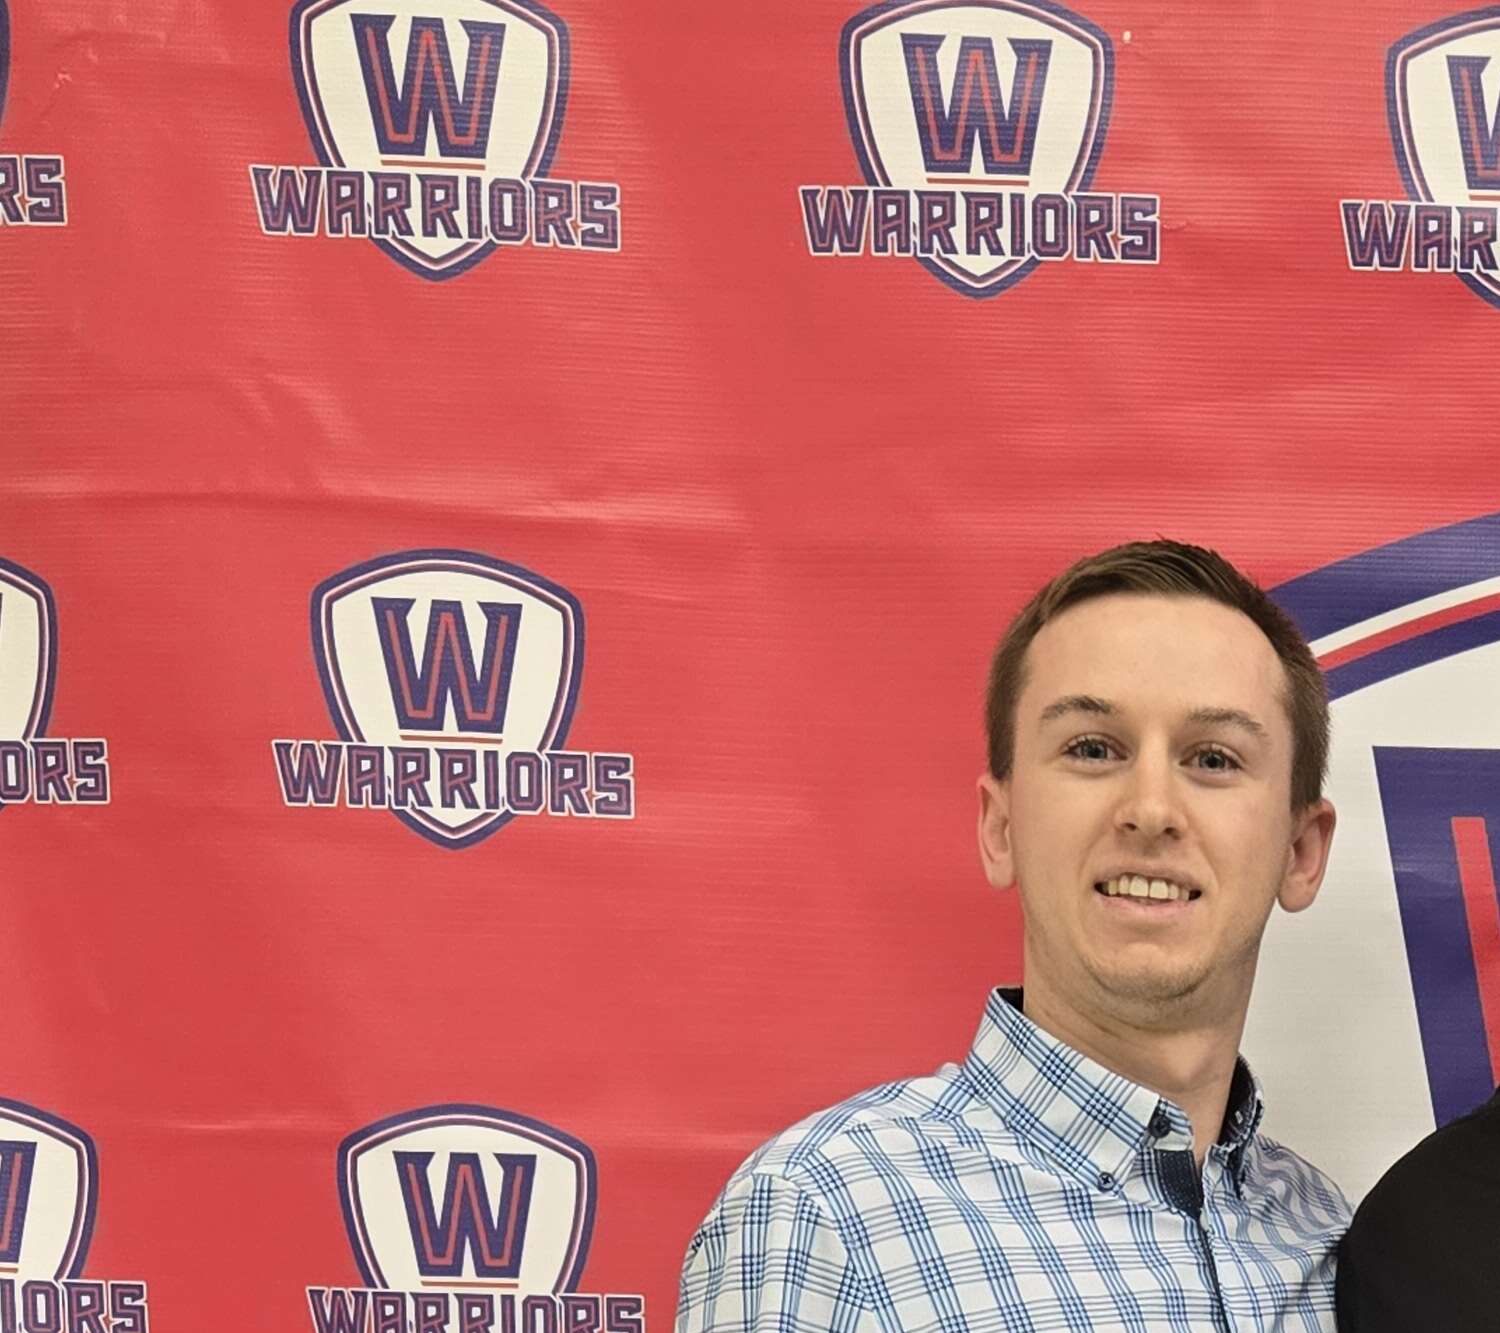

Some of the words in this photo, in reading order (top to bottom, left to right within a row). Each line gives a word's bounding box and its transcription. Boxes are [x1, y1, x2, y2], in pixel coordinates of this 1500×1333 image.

[348, 12, 502, 160] W
[900, 33, 1052, 176] W
[250, 164, 621, 253] WARRIORS
[799, 185, 1160, 264] WARRIORS
[372, 597, 521, 735] W
[272, 738, 634, 818] WARRIORS
[392, 1151, 537, 1278] W
